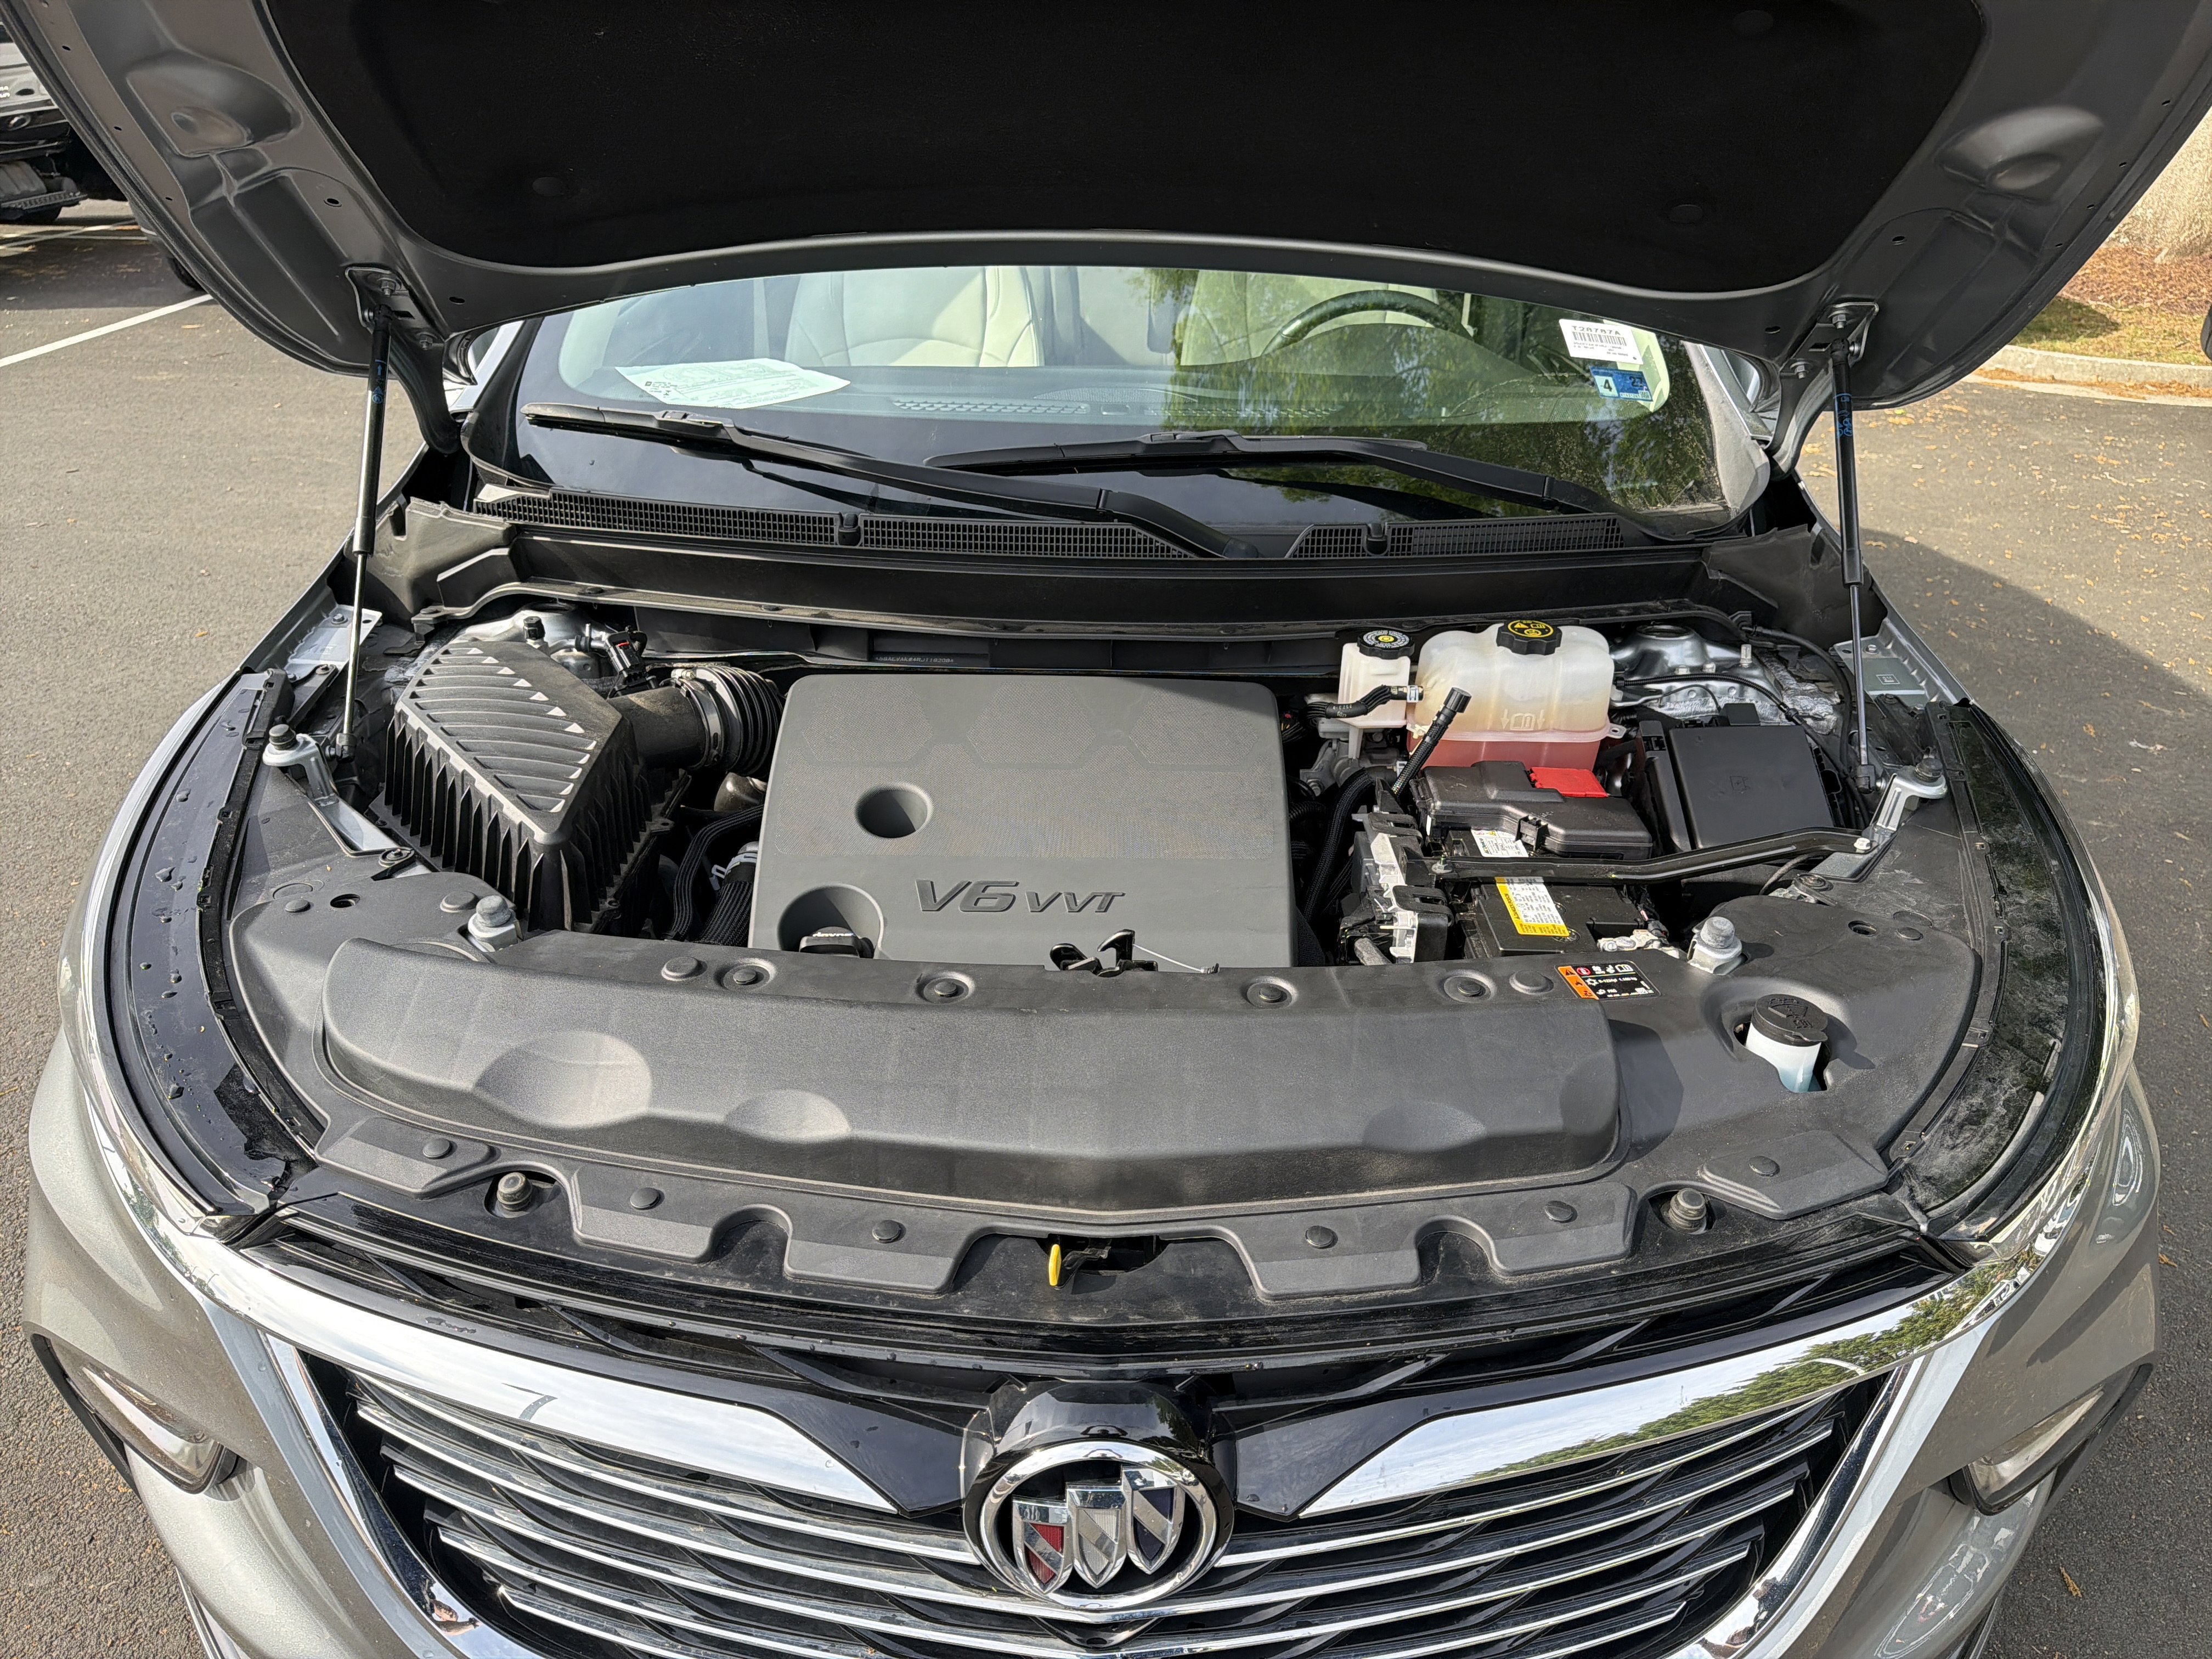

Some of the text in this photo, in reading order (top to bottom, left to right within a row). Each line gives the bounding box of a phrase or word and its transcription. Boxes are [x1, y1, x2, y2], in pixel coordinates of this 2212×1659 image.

[1603, 379, 1612, 392] 4
[915, 879, 1126, 913] V6 VVT
